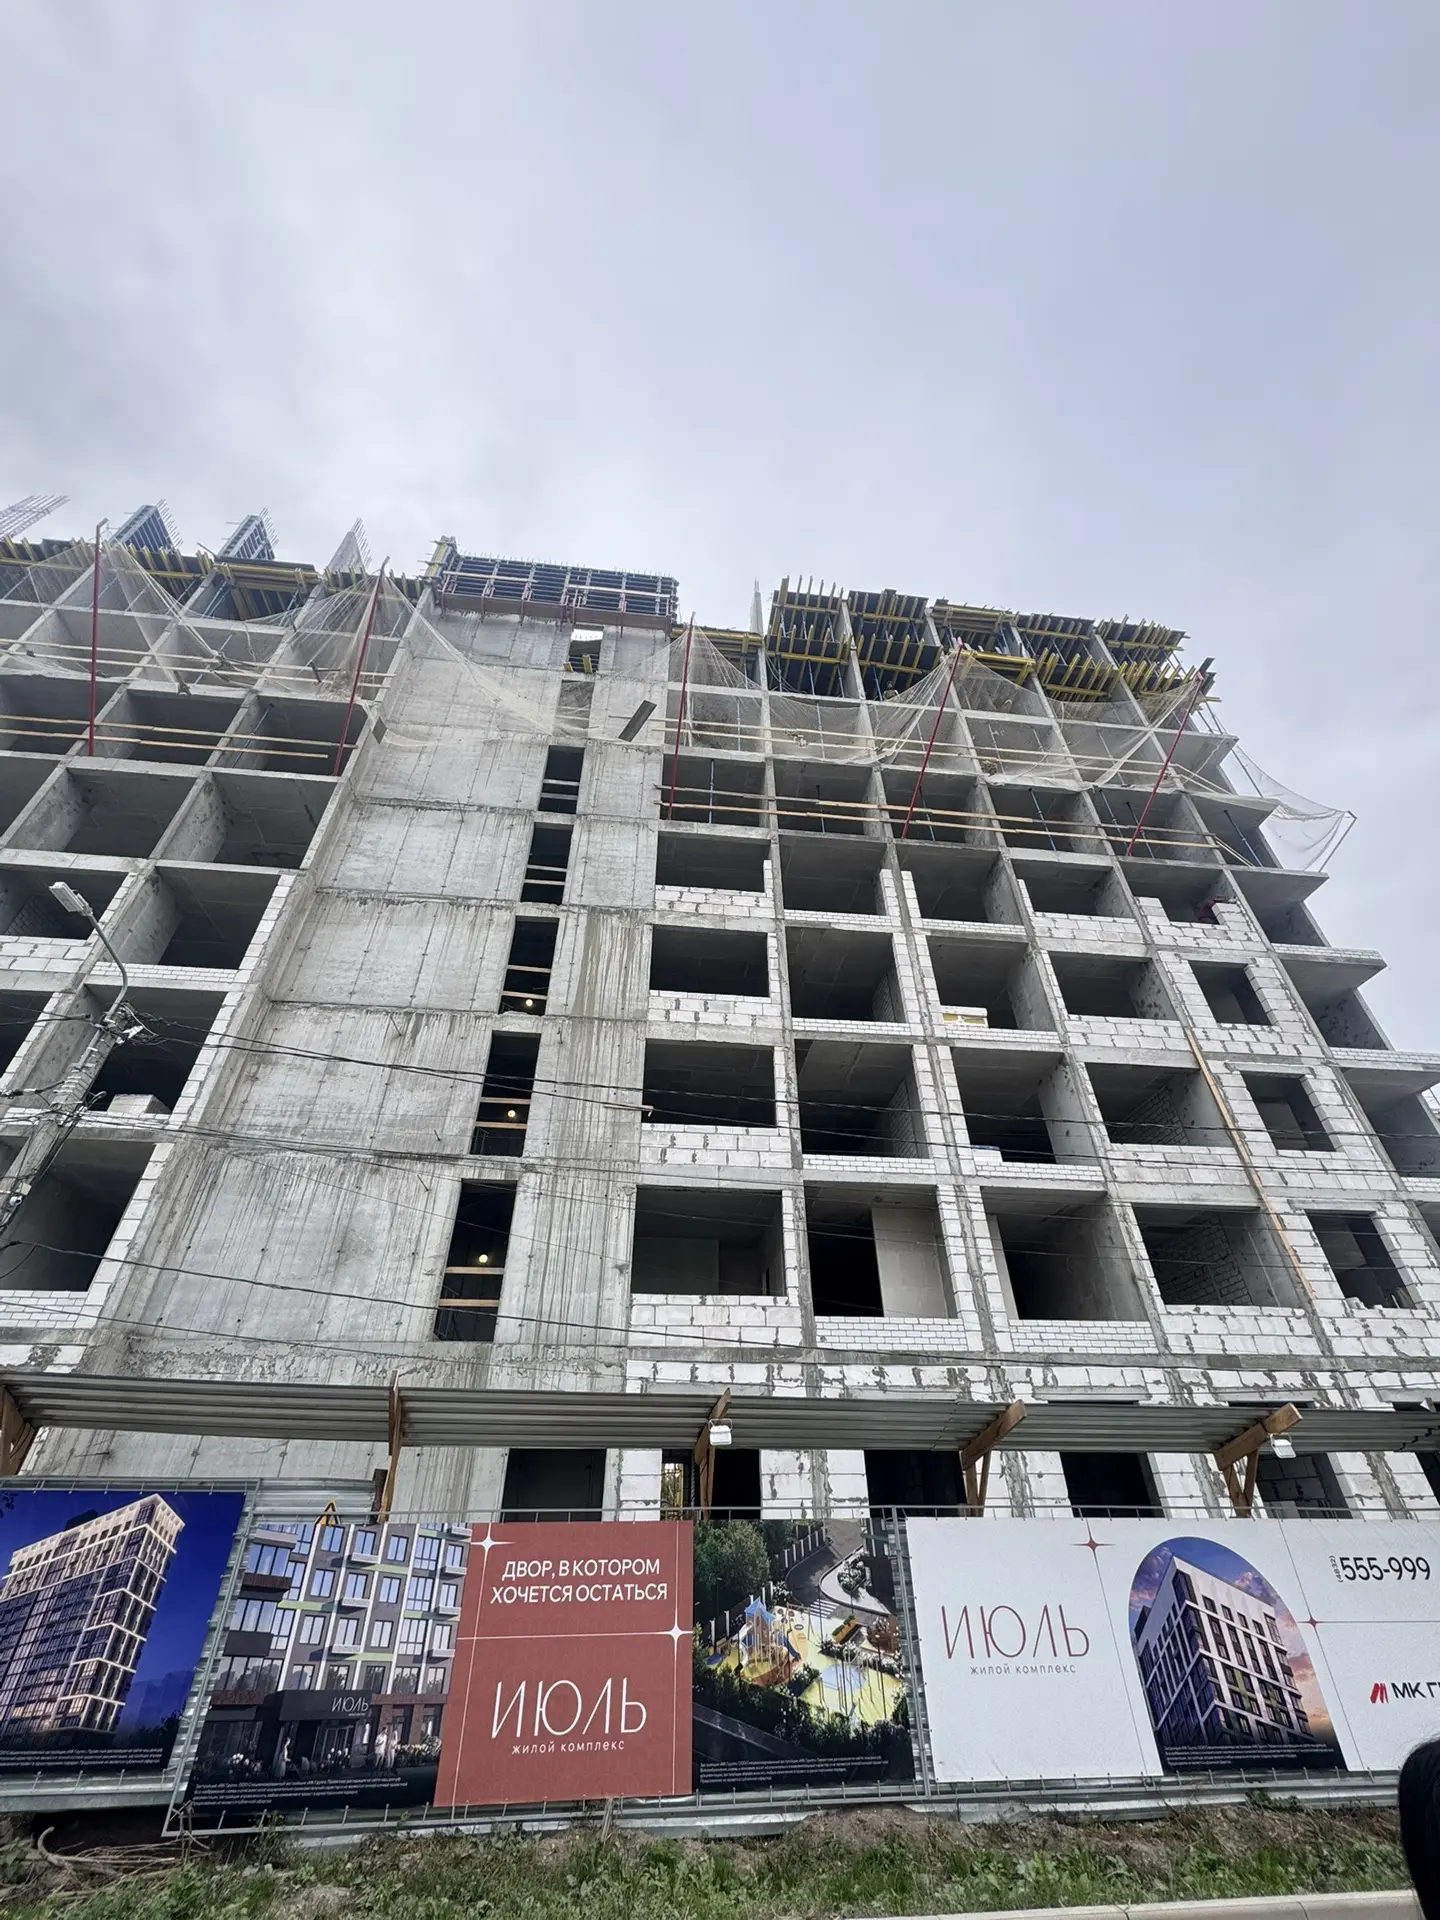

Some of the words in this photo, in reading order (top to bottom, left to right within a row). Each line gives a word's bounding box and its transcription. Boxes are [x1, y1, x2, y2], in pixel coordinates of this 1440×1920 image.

[501, 1560, 556, 1581] ДВОР,
[558, 1560, 570, 1577] В
[572, 1558, 660, 1577] КОТОРОМ
[1339, 1556, 1431, 1581] 555-999
[490, 1585, 573, 1604] ХОЧЕТСЯ
[575, 1583, 668, 1602] ОСТАТЬСЯ
[941, 1604, 1090, 1660] ИЮЛЬ
[970, 1664, 1011, 1675] жилой
[1015, 1664, 1076, 1674] комплекс
[1391, 1682, 1427, 1699] МК
[331, 1696, 369, 1712] ИЮЛЬ
[491, 1677, 647, 1739] ИЮЛЬ
[511, 1741, 555, 1755] жилой
[560, 1740, 625, 1752] комплекс
